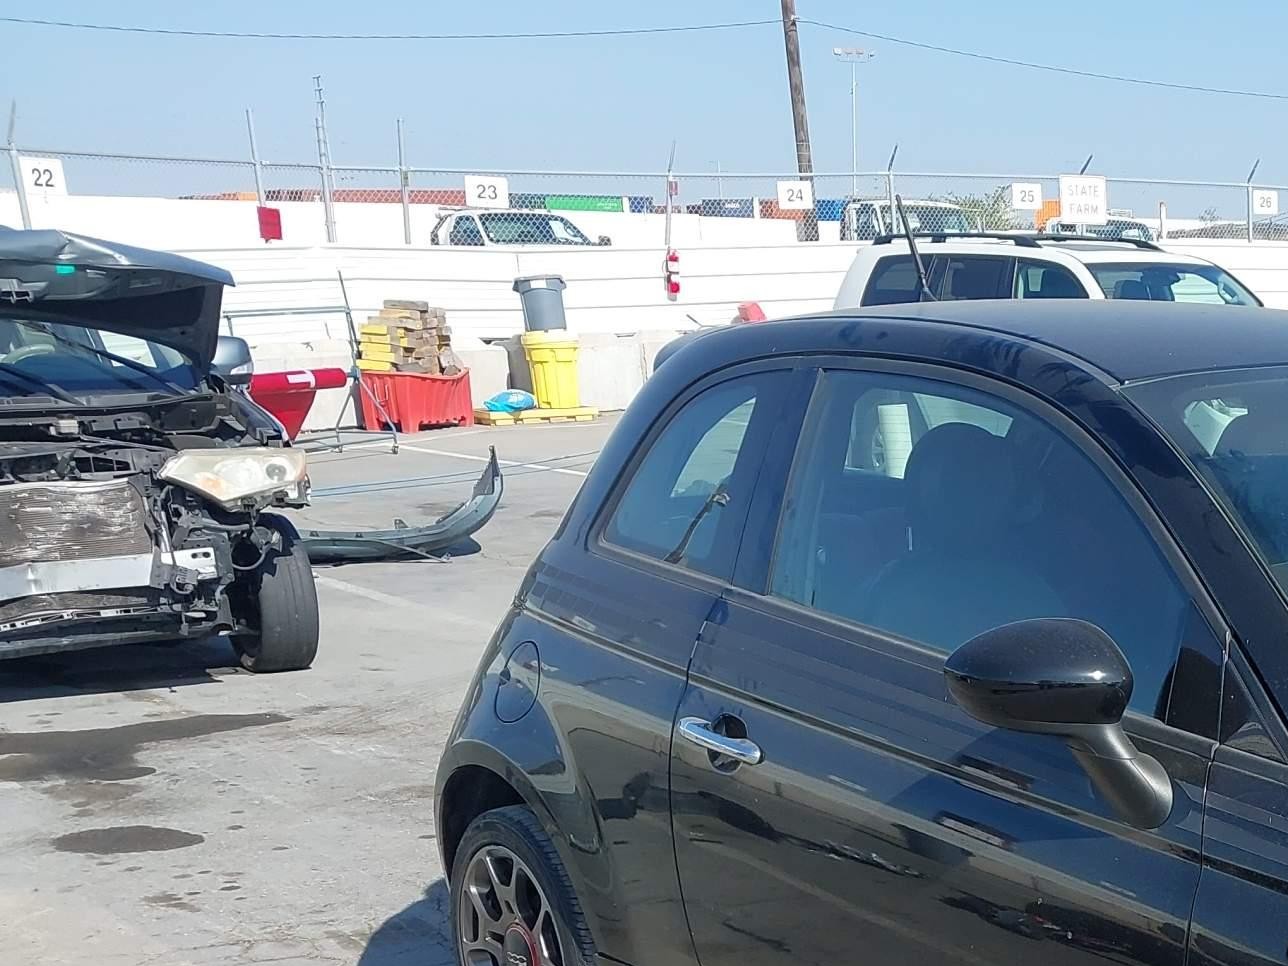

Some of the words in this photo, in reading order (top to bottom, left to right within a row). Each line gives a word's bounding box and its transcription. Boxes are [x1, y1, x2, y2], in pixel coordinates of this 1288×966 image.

[31, 167, 55, 188] 22
[476, 184, 498, 200] 23
[787, 188, 803, 203] 24
[1020, 190, 1035, 203] 25
[1068, 184, 1101, 198] STATE
[1259, 196, 1273, 208] 26
[1069, 203, 1100, 216] FARM
